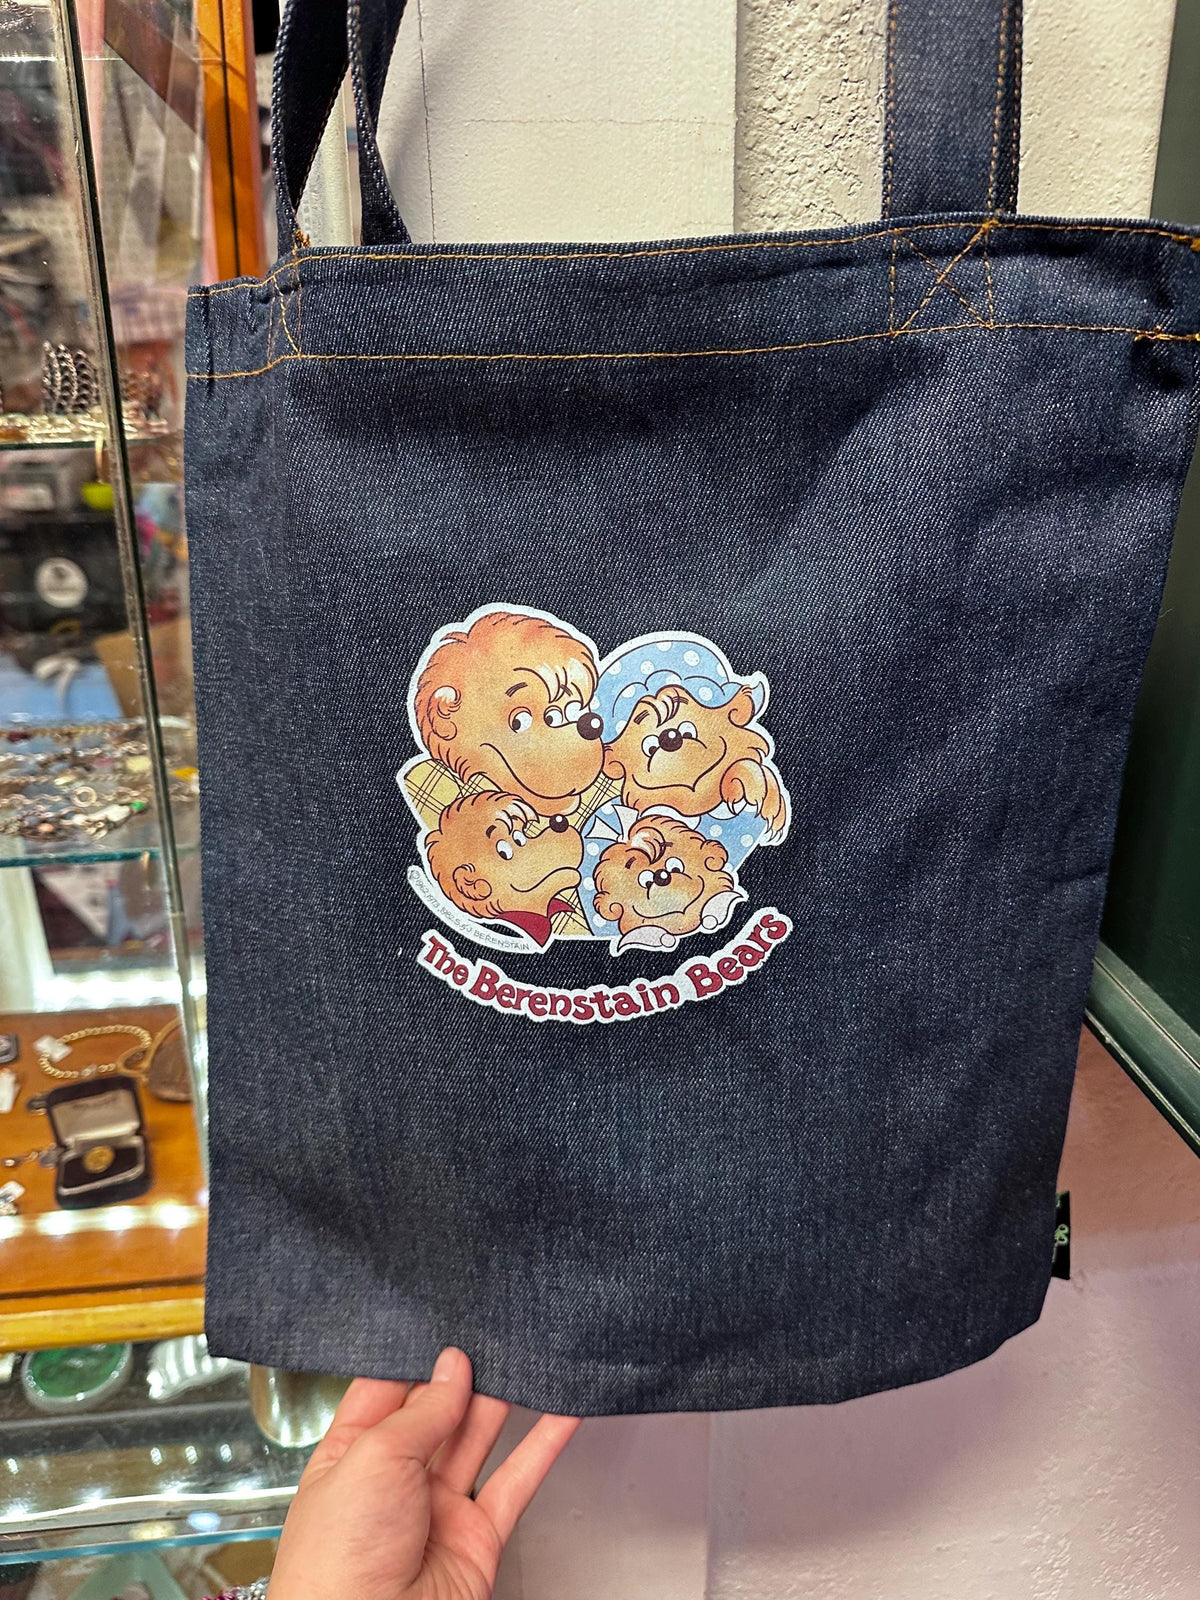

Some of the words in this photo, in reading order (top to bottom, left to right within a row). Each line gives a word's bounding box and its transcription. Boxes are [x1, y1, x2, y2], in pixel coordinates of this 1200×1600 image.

[423, 935, 470, 987] The
[467, 964, 681, 1021] Berenstain
[685, 913, 788, 999] Bears
[474, 929, 530, 951] BERENSTAIN
